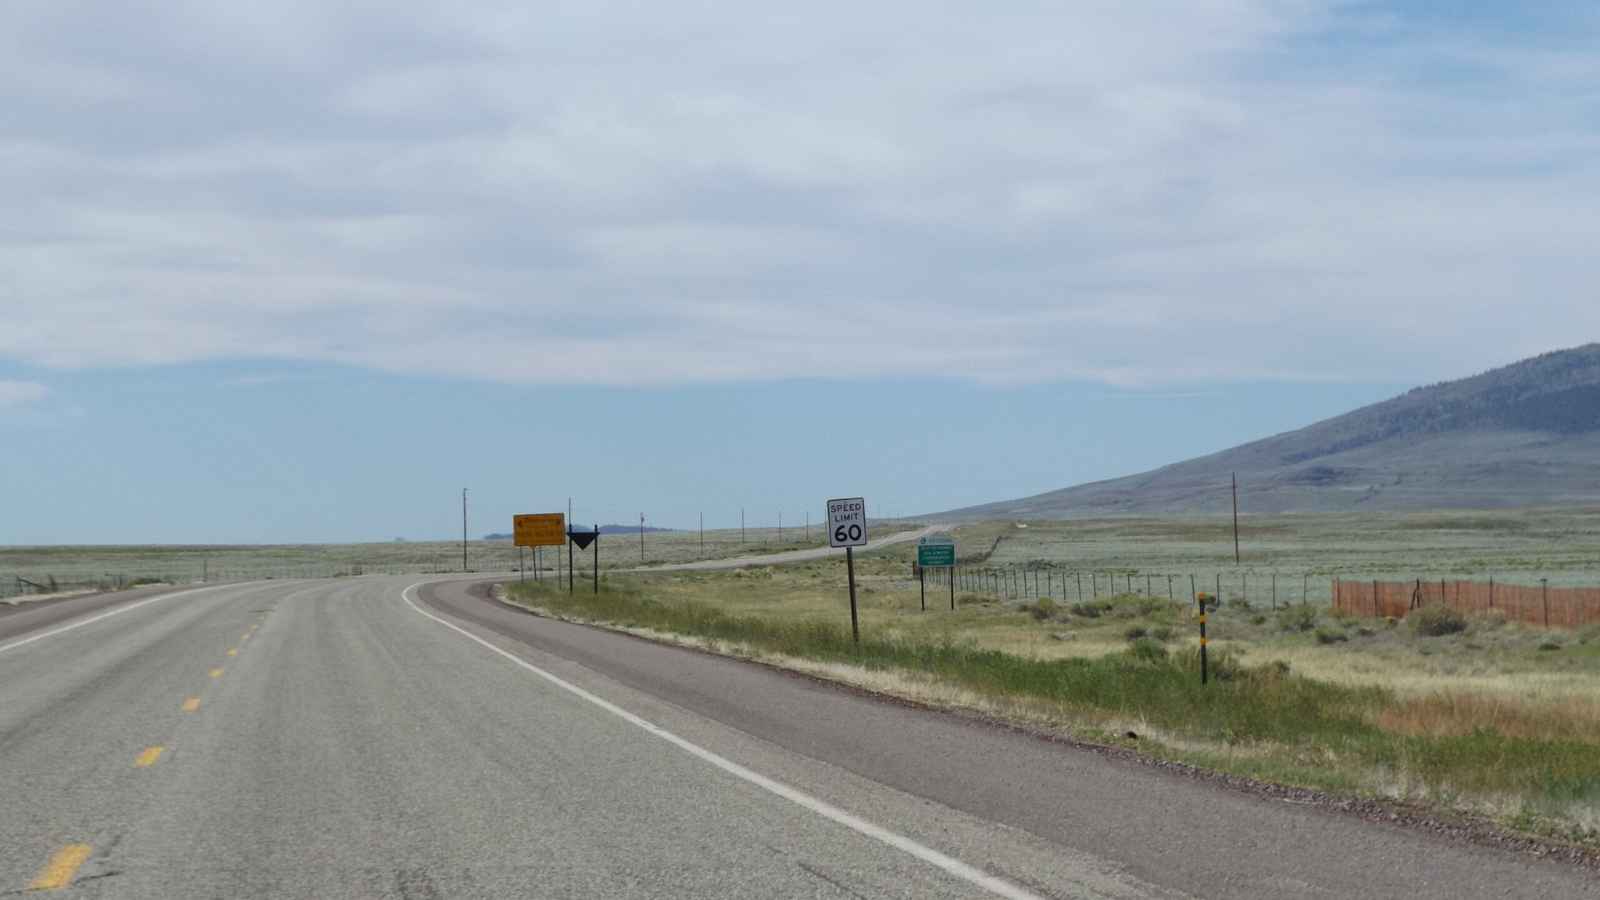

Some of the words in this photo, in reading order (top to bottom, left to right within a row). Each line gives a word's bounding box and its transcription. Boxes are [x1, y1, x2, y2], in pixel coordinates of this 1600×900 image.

[831, 503, 861, 512] SPEED
[835, 513, 858, 522] LIMIT
[835, 524, 861, 542] 60
